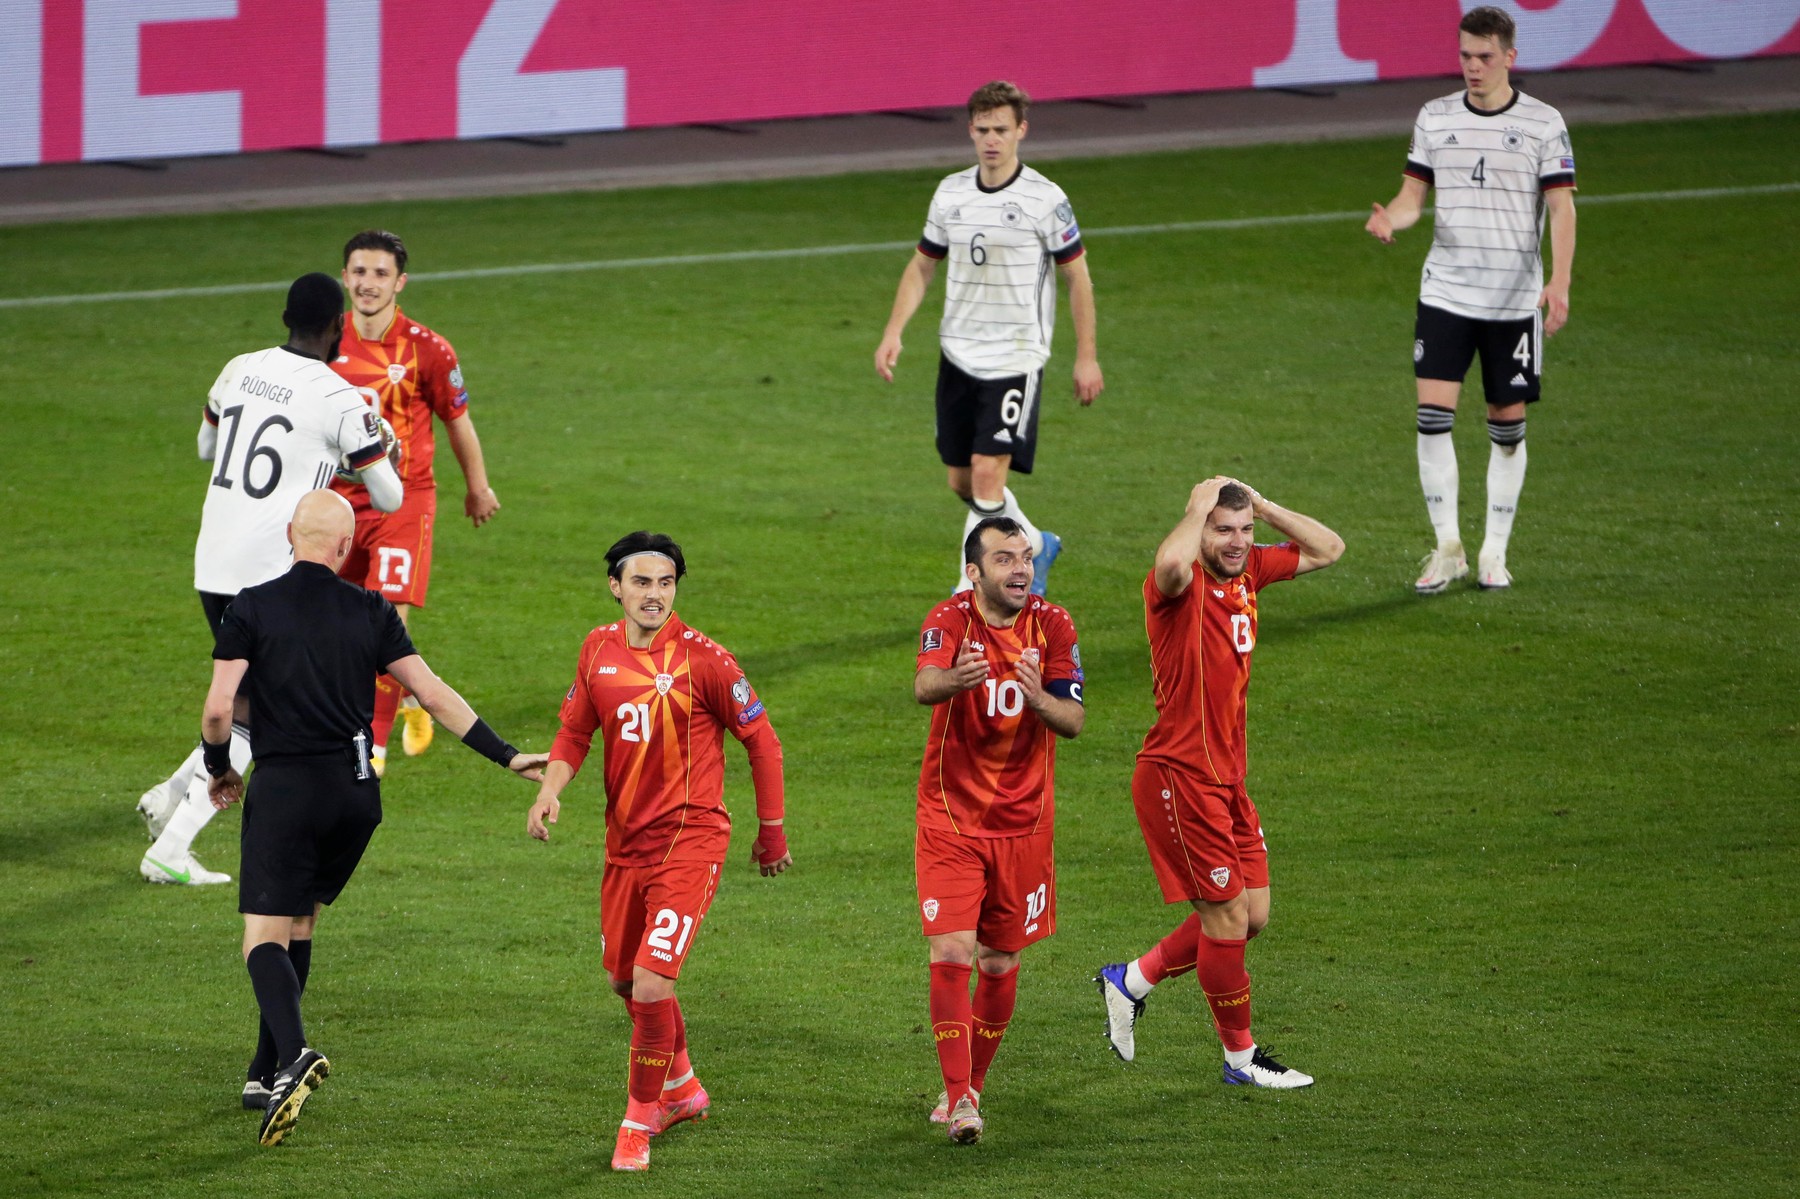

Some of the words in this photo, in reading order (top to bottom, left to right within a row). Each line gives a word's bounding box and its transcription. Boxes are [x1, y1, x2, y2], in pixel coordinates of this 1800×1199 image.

[1471, 156, 1486, 189] 4
[969, 232, 987, 266] 6
[1512, 332, 1531, 368] 4
[239, 375, 293, 405] RÜDIGER
[1001, 388, 1023, 425] 6
[212, 404, 294, 500] 16
[1212, 589, 1225, 598] KO
[970, 640, 985, 652] JAO
[1230, 614, 1253, 653] 13
[598, 666, 617, 675] JAKO
[985, 679, 1024, 718] 10
[616, 702, 651, 743] 21
[1023, 883, 1047, 927] 10
[647, 908, 694, 956] 21
[1025, 922, 1039, 936] JAKO
[650, 948, 673, 962] JAKO
[1217, 993, 1250, 1007] JAKO
[934, 1029, 960, 1042] AKO
[635, 1055, 667, 1067] JAKO
